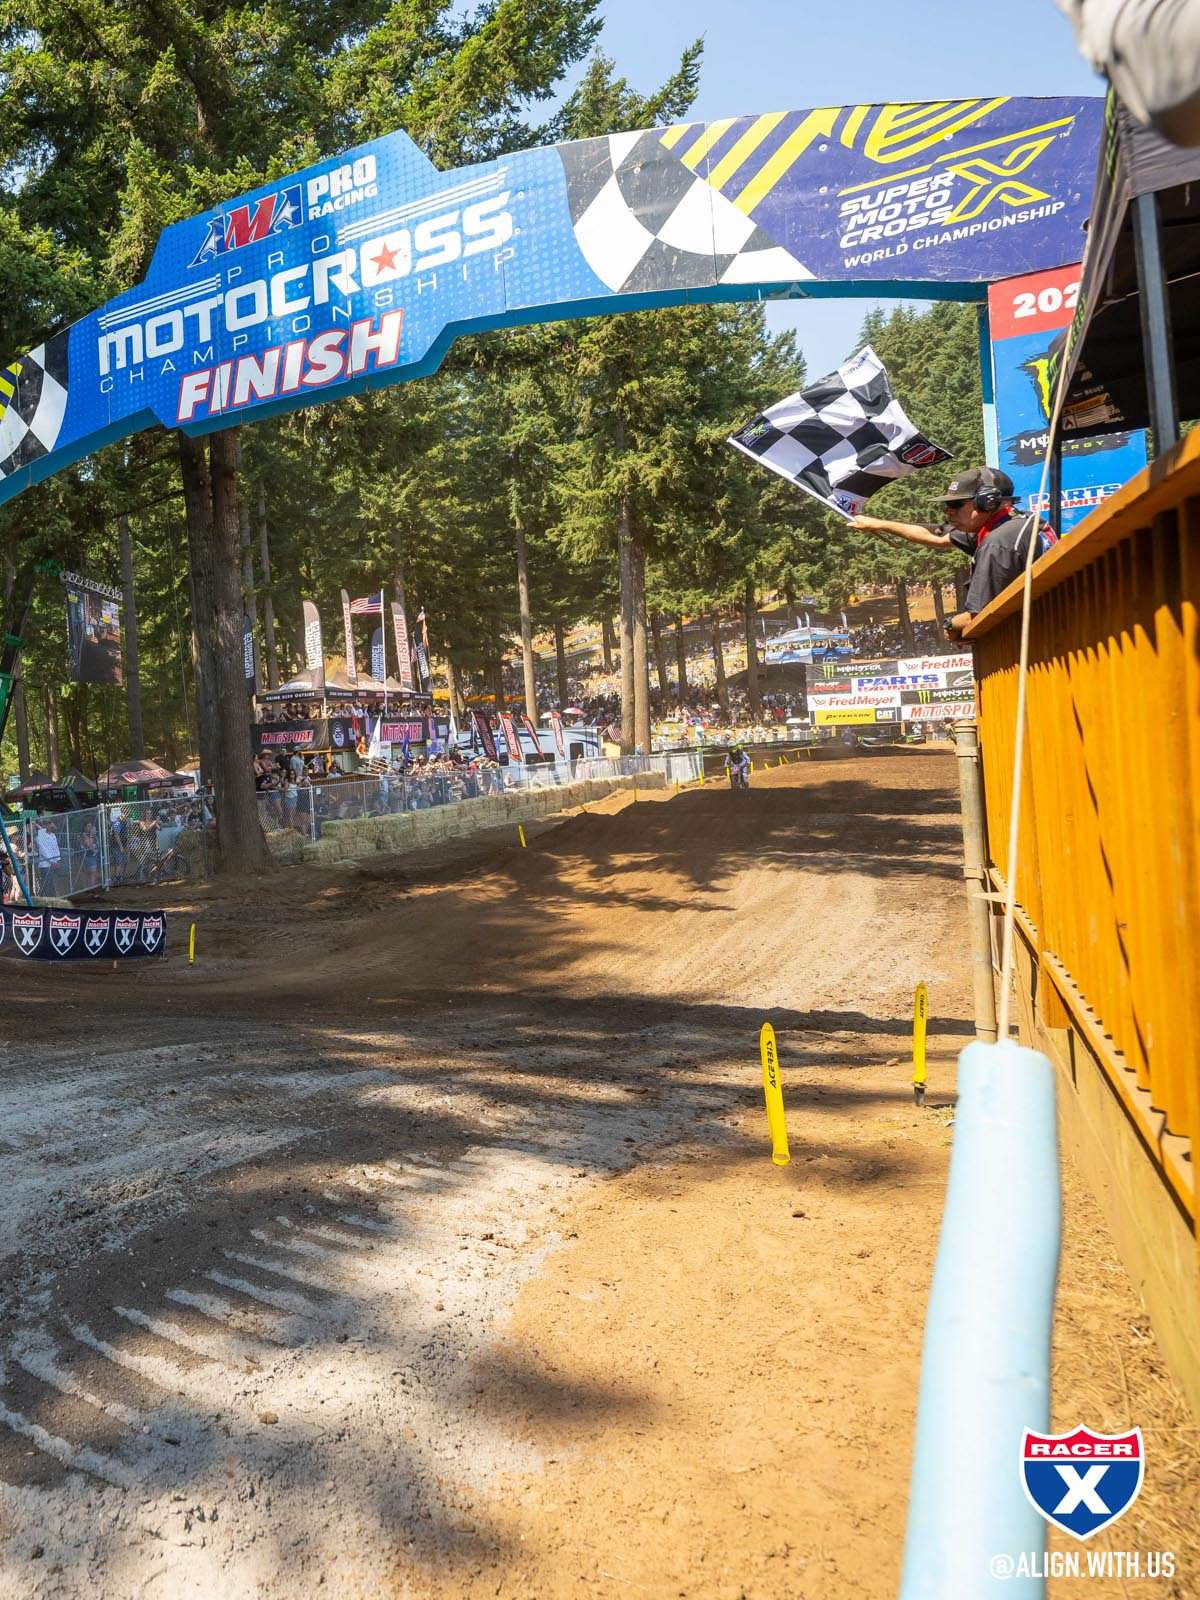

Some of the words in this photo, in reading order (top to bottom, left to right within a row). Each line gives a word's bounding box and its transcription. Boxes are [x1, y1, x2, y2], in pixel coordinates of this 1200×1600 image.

[307, 154, 376, 206] PRO
[308, 183, 378, 221] RACING
[838, 171, 955, 219] SUPER
[186, 183, 304, 269] AMA
[839, 205, 954, 250] CROSS
[846, 189, 949, 233] MOTO
[228, 235, 330, 284] PRO
[844, 242, 908, 270] WORLD
[913, 201, 1066, 251] CHAMPIONSHIP
[98, 190, 513, 376] MOTOCROSS
[100, 248, 514, 394] CHAMPIONSHIP
[176, 308, 405, 424] FINISH
[836, 664, 883, 673] MONSTER
[858, 674, 939, 687] PARTS
[876, 709, 894, 720] CAT
[933, 688, 974, 698] MONSTE
[765, 1040, 777, 1089] ACERBIS
